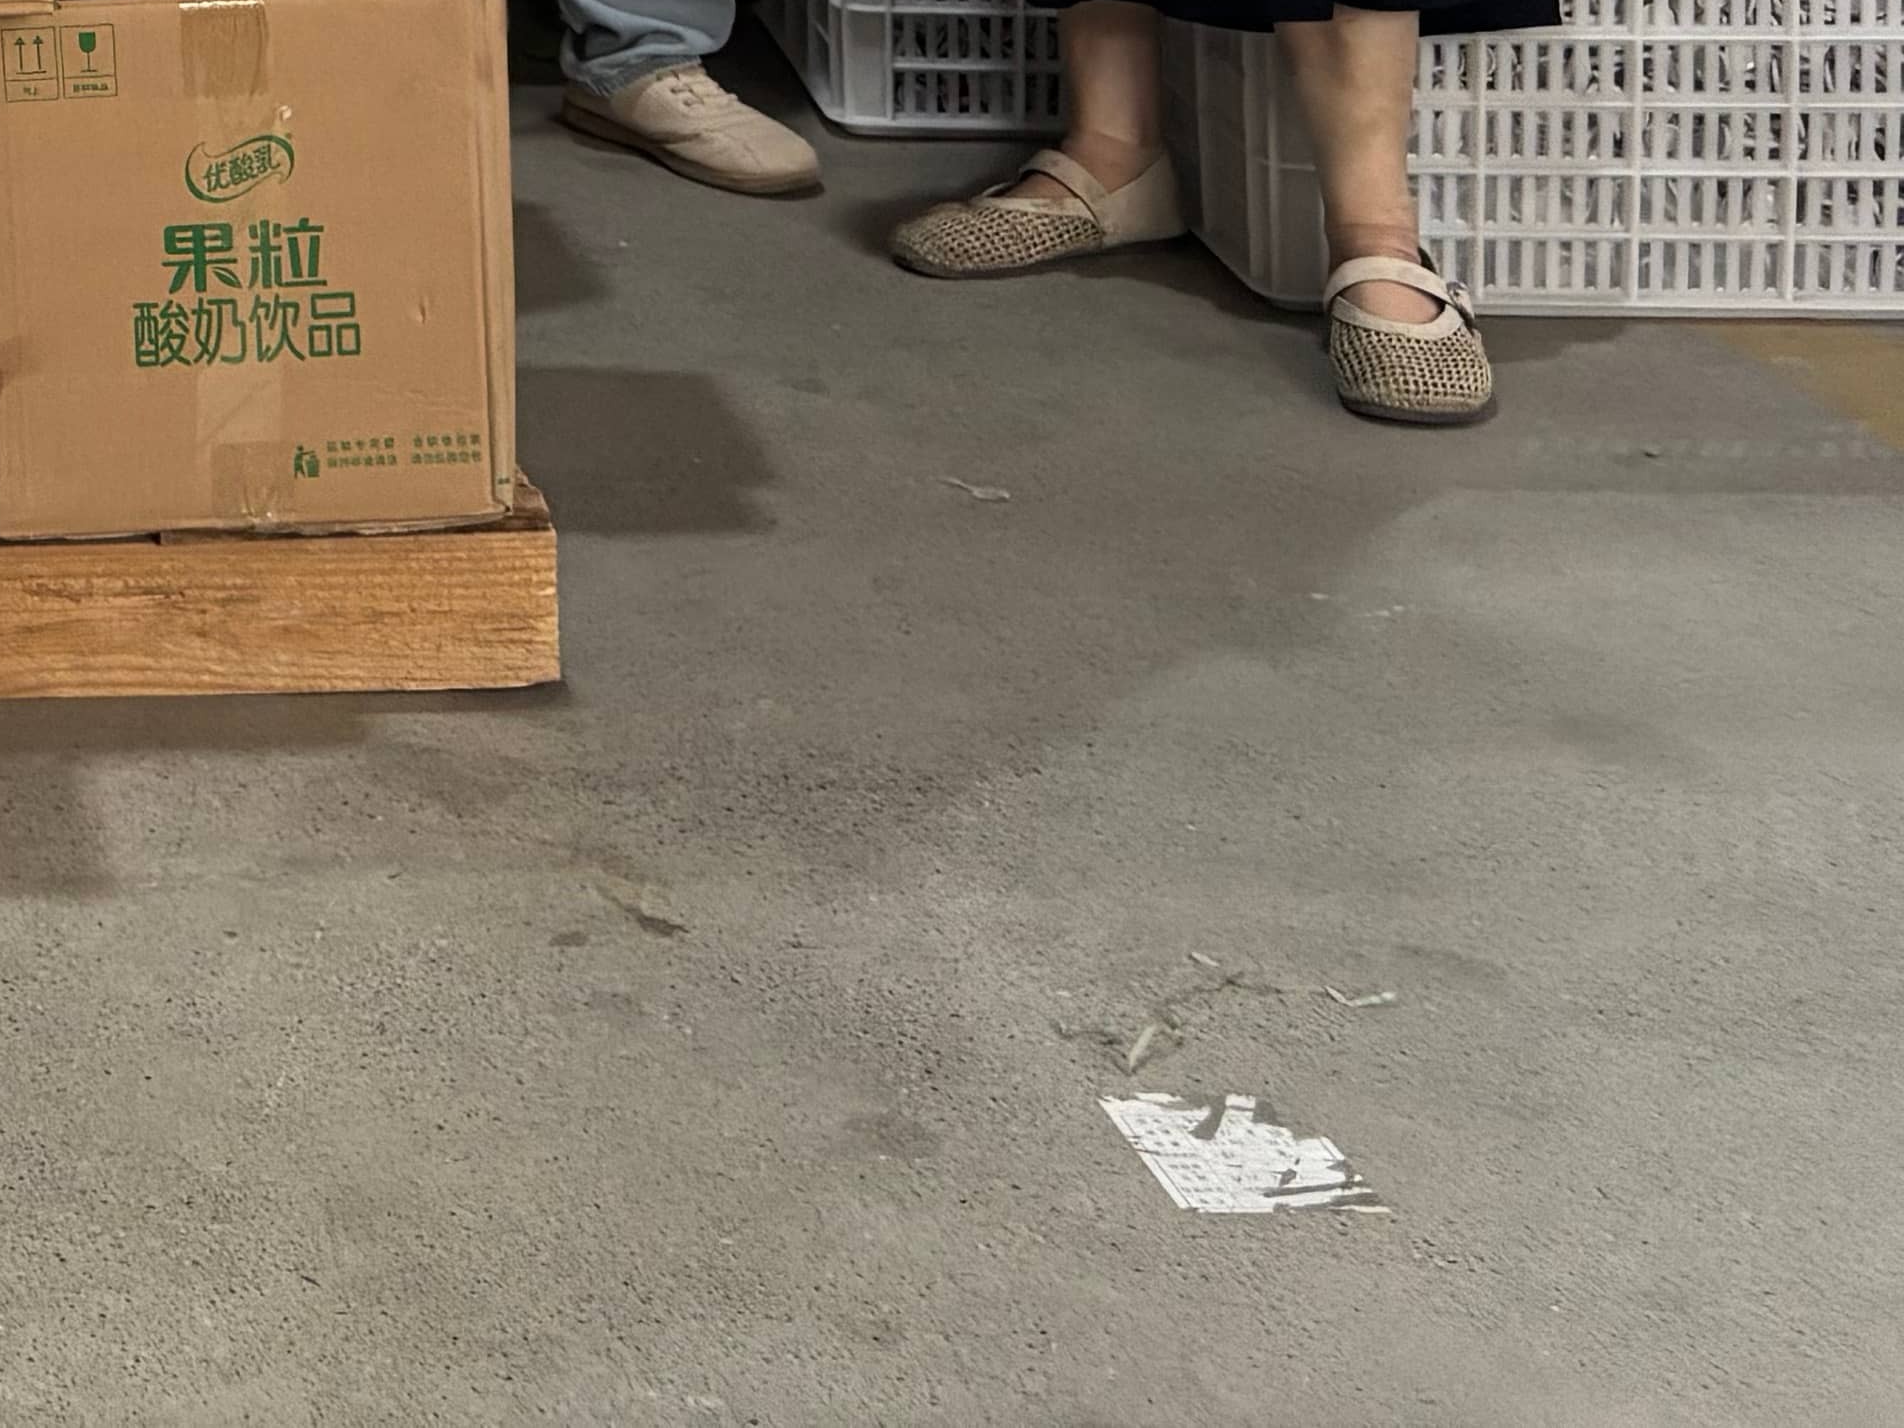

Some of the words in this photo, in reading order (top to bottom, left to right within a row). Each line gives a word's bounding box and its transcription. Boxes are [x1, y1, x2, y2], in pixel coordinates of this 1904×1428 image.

[202, 143, 280, 192] 优酸乳
[162, 217, 327, 293] 果粒
[133, 291, 361, 368] 酸奶饮品
